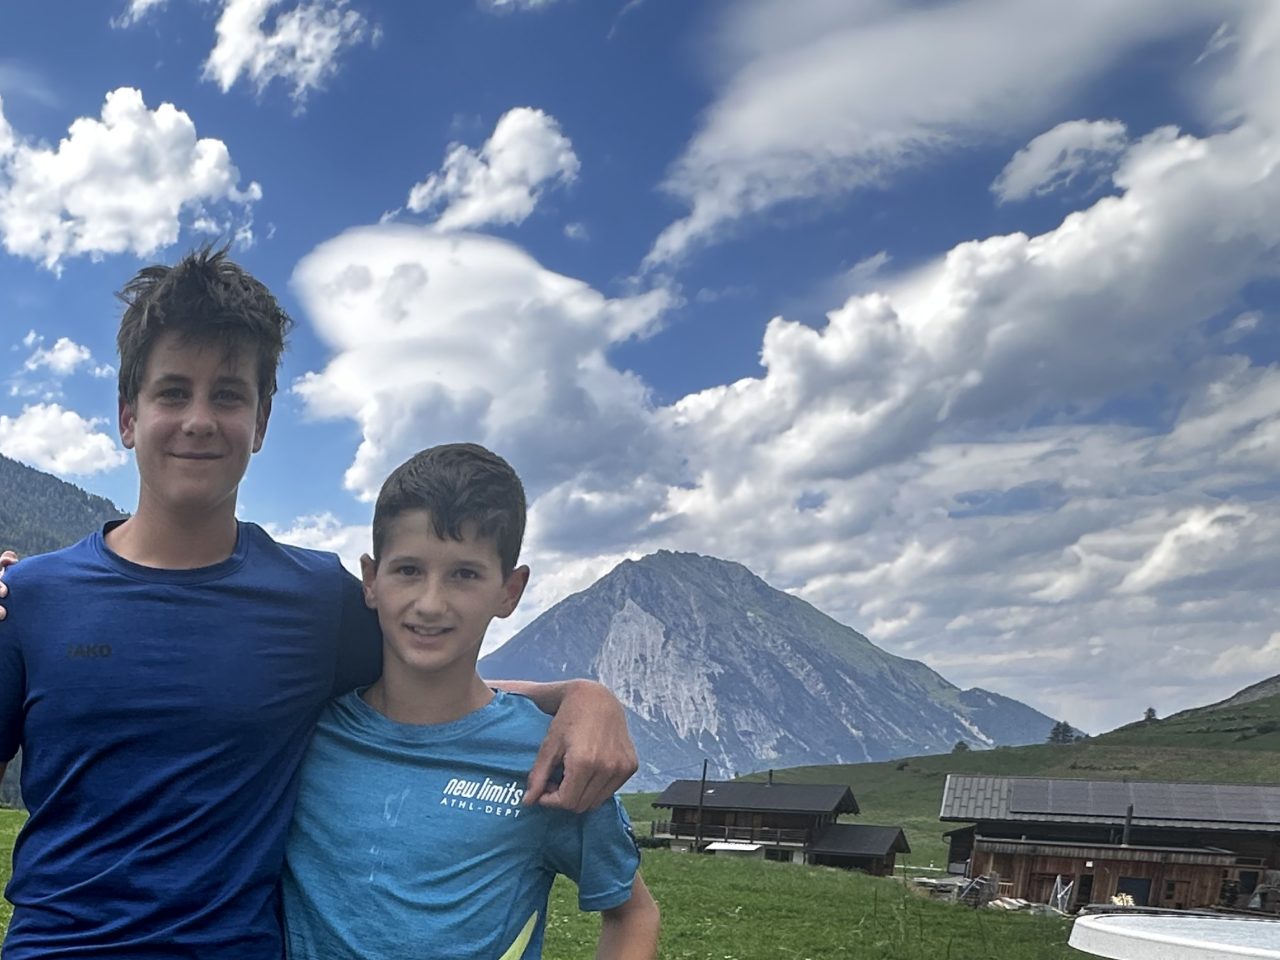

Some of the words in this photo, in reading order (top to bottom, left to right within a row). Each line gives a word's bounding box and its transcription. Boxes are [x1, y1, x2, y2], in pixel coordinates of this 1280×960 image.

[443, 778, 480, 799] new
[476, 777, 524, 806] limits
[440, 797, 521, 818] ATHL-DEPT
